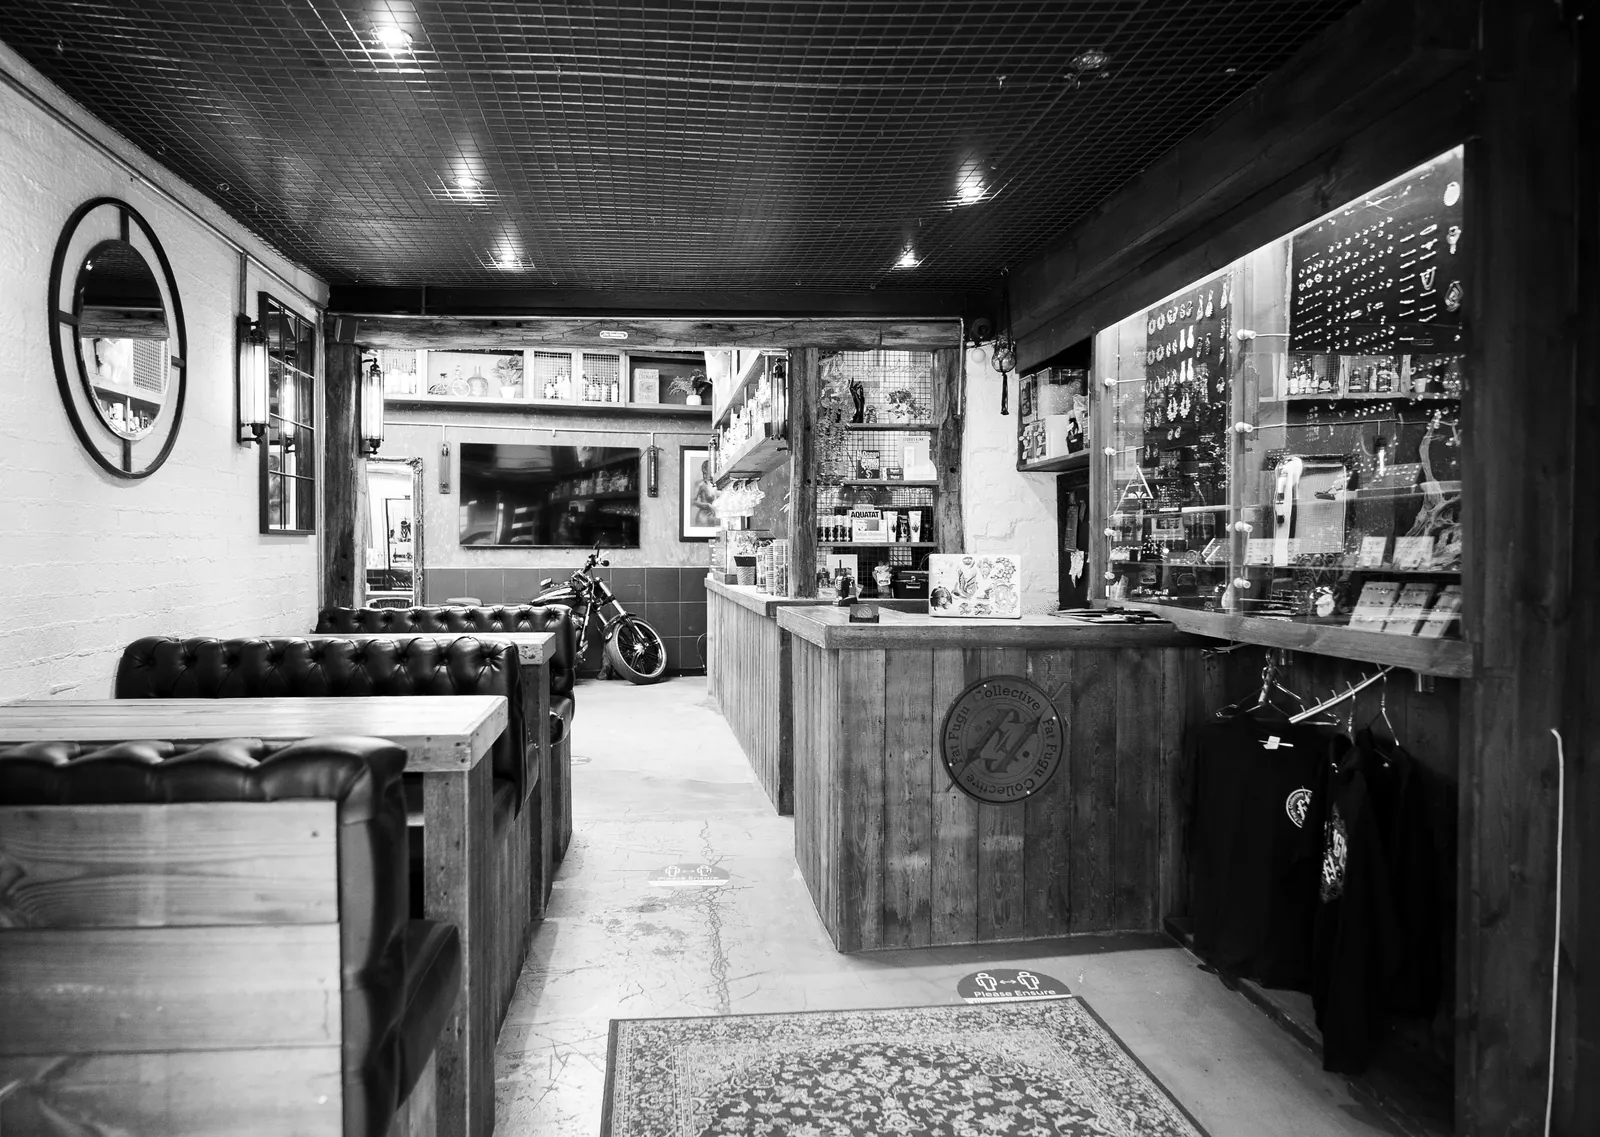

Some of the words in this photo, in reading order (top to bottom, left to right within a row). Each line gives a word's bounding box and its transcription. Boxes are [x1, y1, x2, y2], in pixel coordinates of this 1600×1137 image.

[973, 685, 1041, 711] Collective
[948, 705, 971, 742] Fugu
[1042, 717, 1057, 737] Fat
[951, 744, 964, 767] Fat
[1034, 743, 1058, 779] Fugu
[966, 772, 1036, 797] Collective
